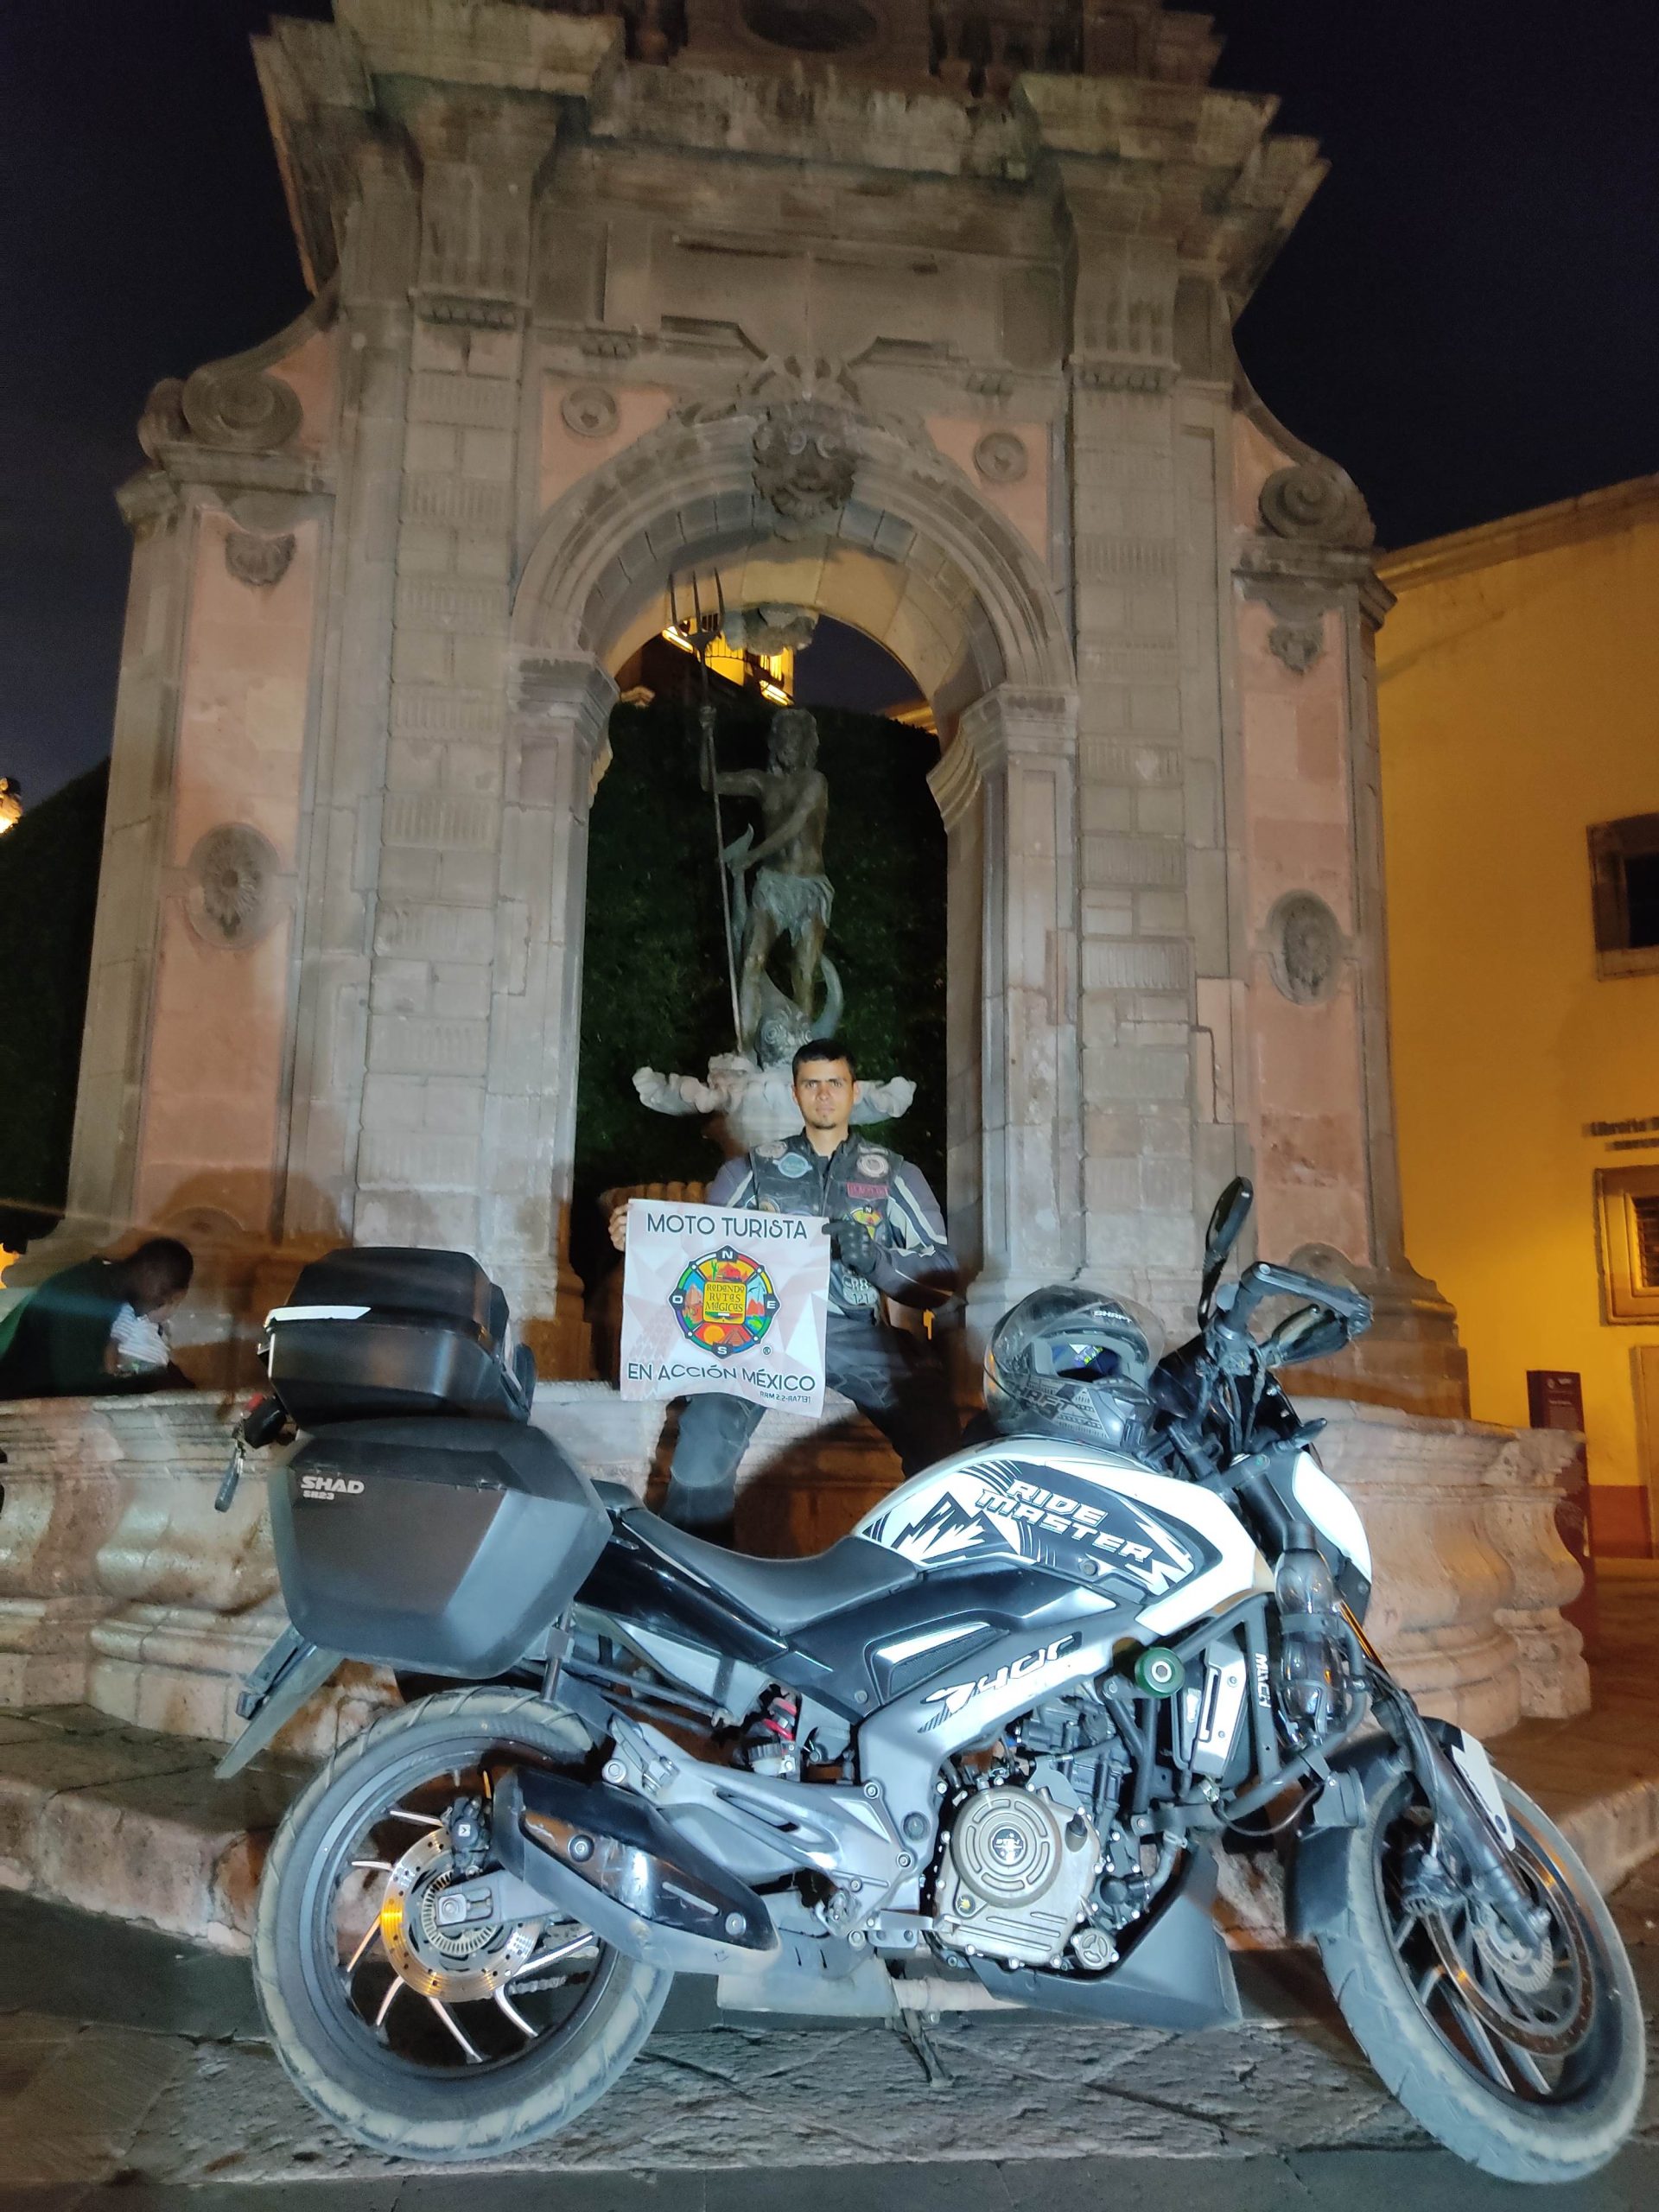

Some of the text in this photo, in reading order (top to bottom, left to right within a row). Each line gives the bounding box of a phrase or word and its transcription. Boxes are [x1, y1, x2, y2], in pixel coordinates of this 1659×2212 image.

[647, 1213, 807, 1239] MOTO TURISTA
[721, 1250, 734, 1259] N
[766, 1300, 777, 1309] E
[716, 1345, 728, 1355] S
[627, 1363, 816, 1391] EN ACCIÓN MÉXICO
[300, 1476, 365, 1494] SHAD
[1005, 1478, 1109, 1528] RIDE
[975, 1488, 1154, 1563] MASTER
